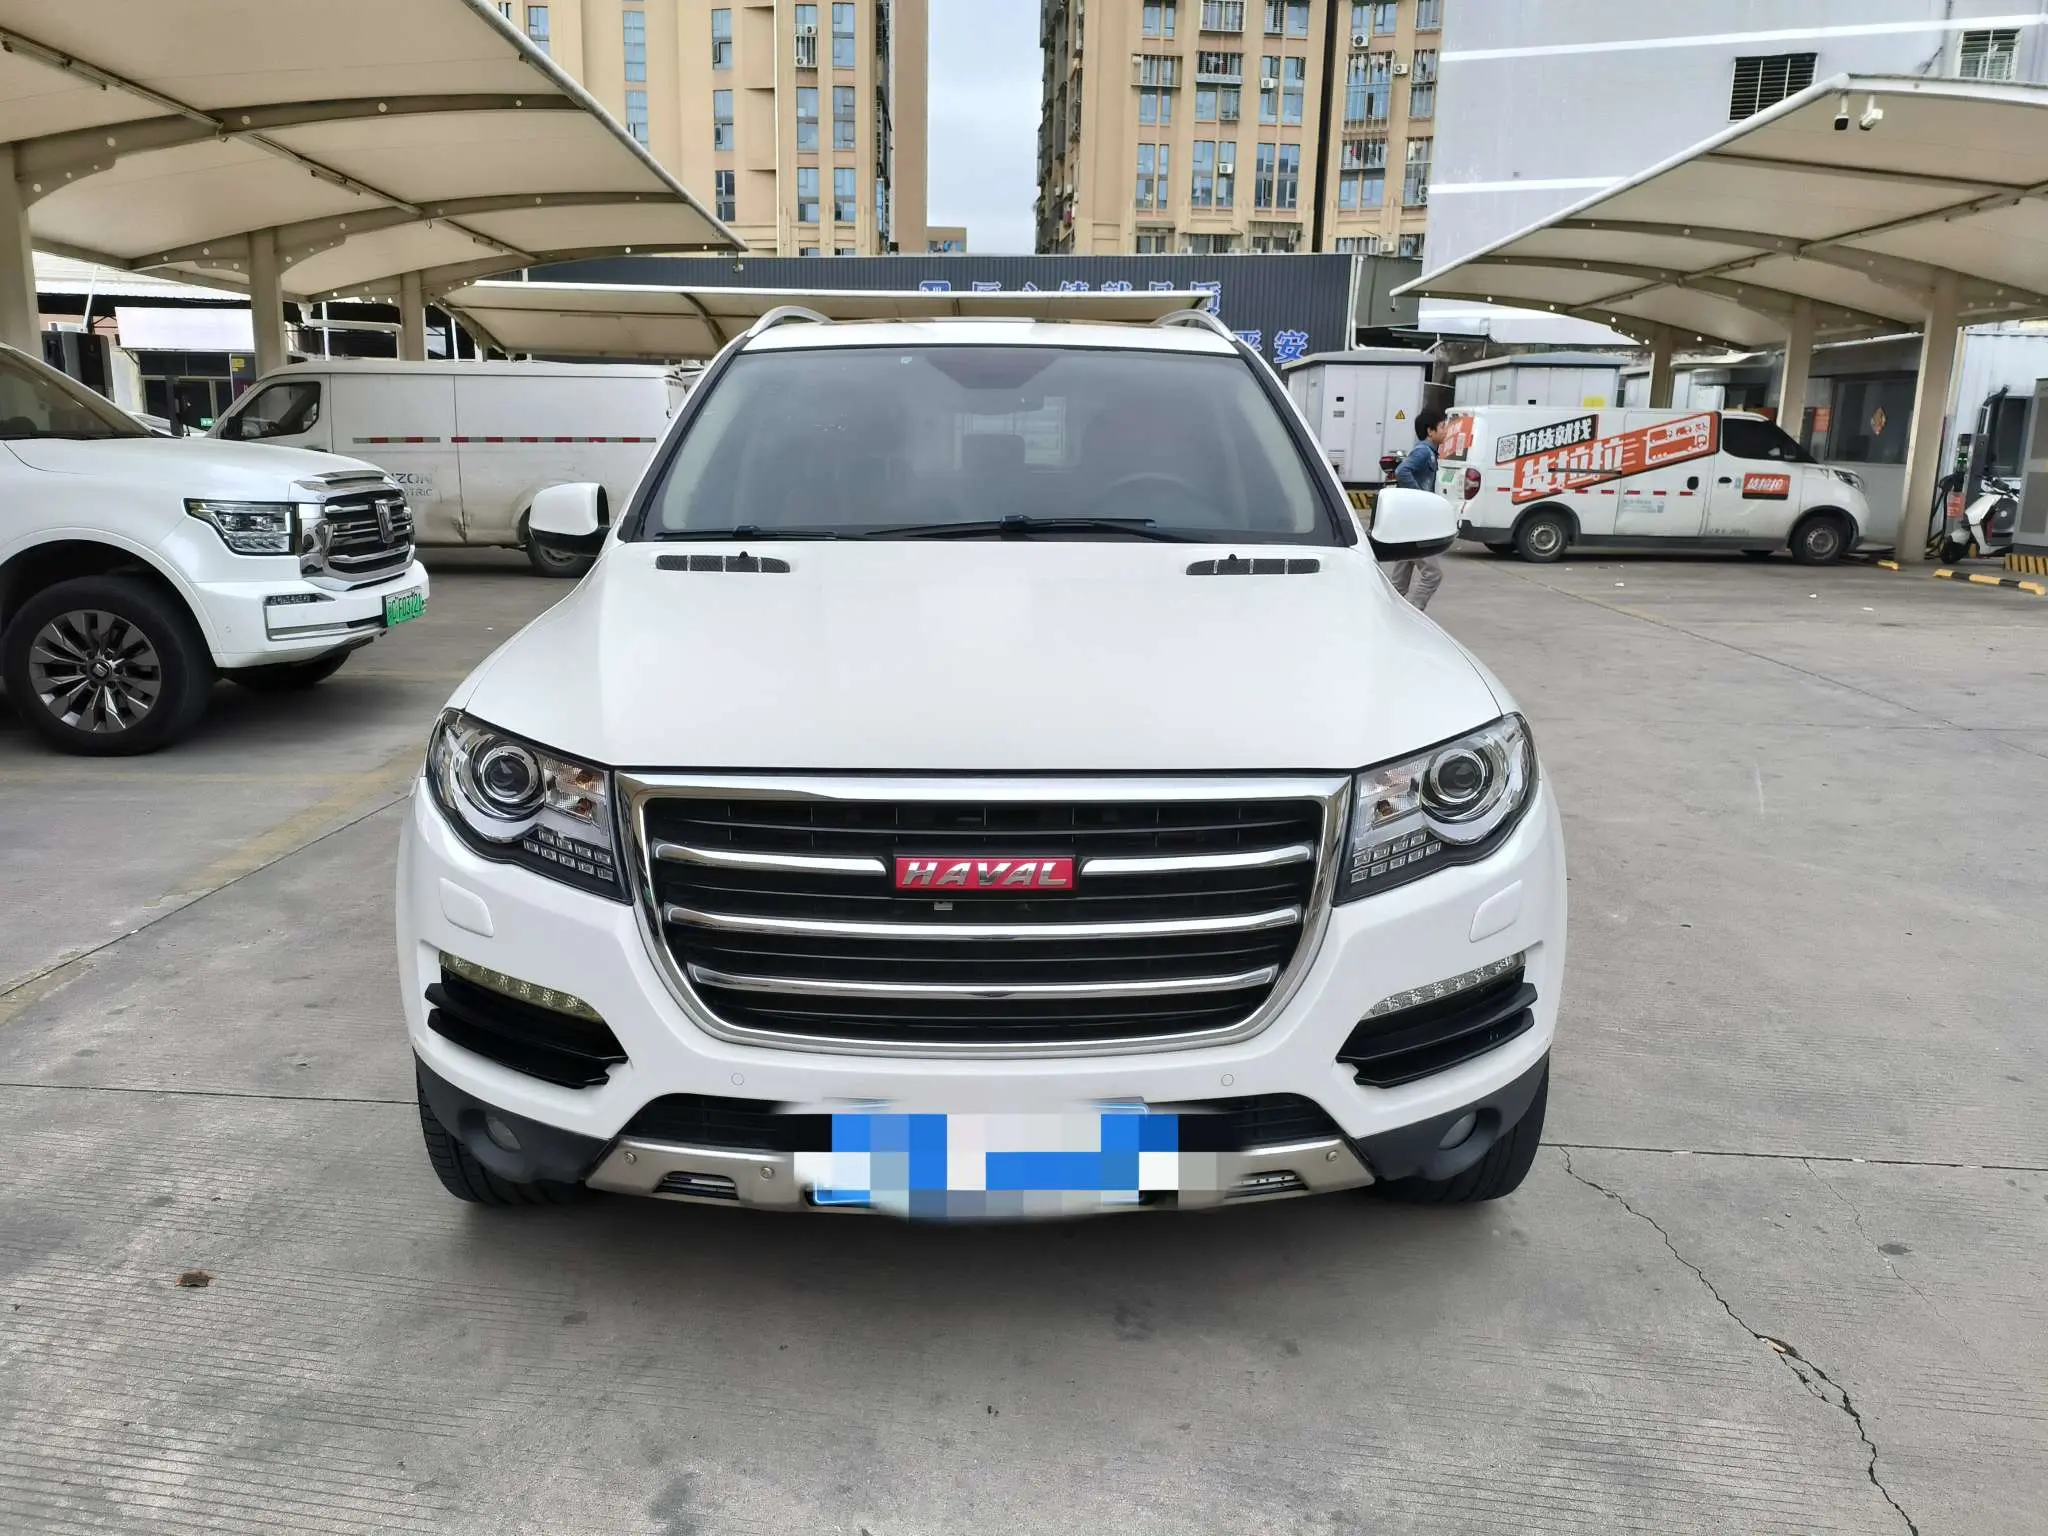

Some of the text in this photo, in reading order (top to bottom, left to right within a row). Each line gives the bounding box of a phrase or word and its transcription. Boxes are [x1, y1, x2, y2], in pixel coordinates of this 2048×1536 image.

[1518, 418, 1592, 456] 拉货就找
[392, 472, 433, 484] ZON
[1521, 437, 1625, 496] 货拉拉
[902, 861, 1068, 886] HAVAL
